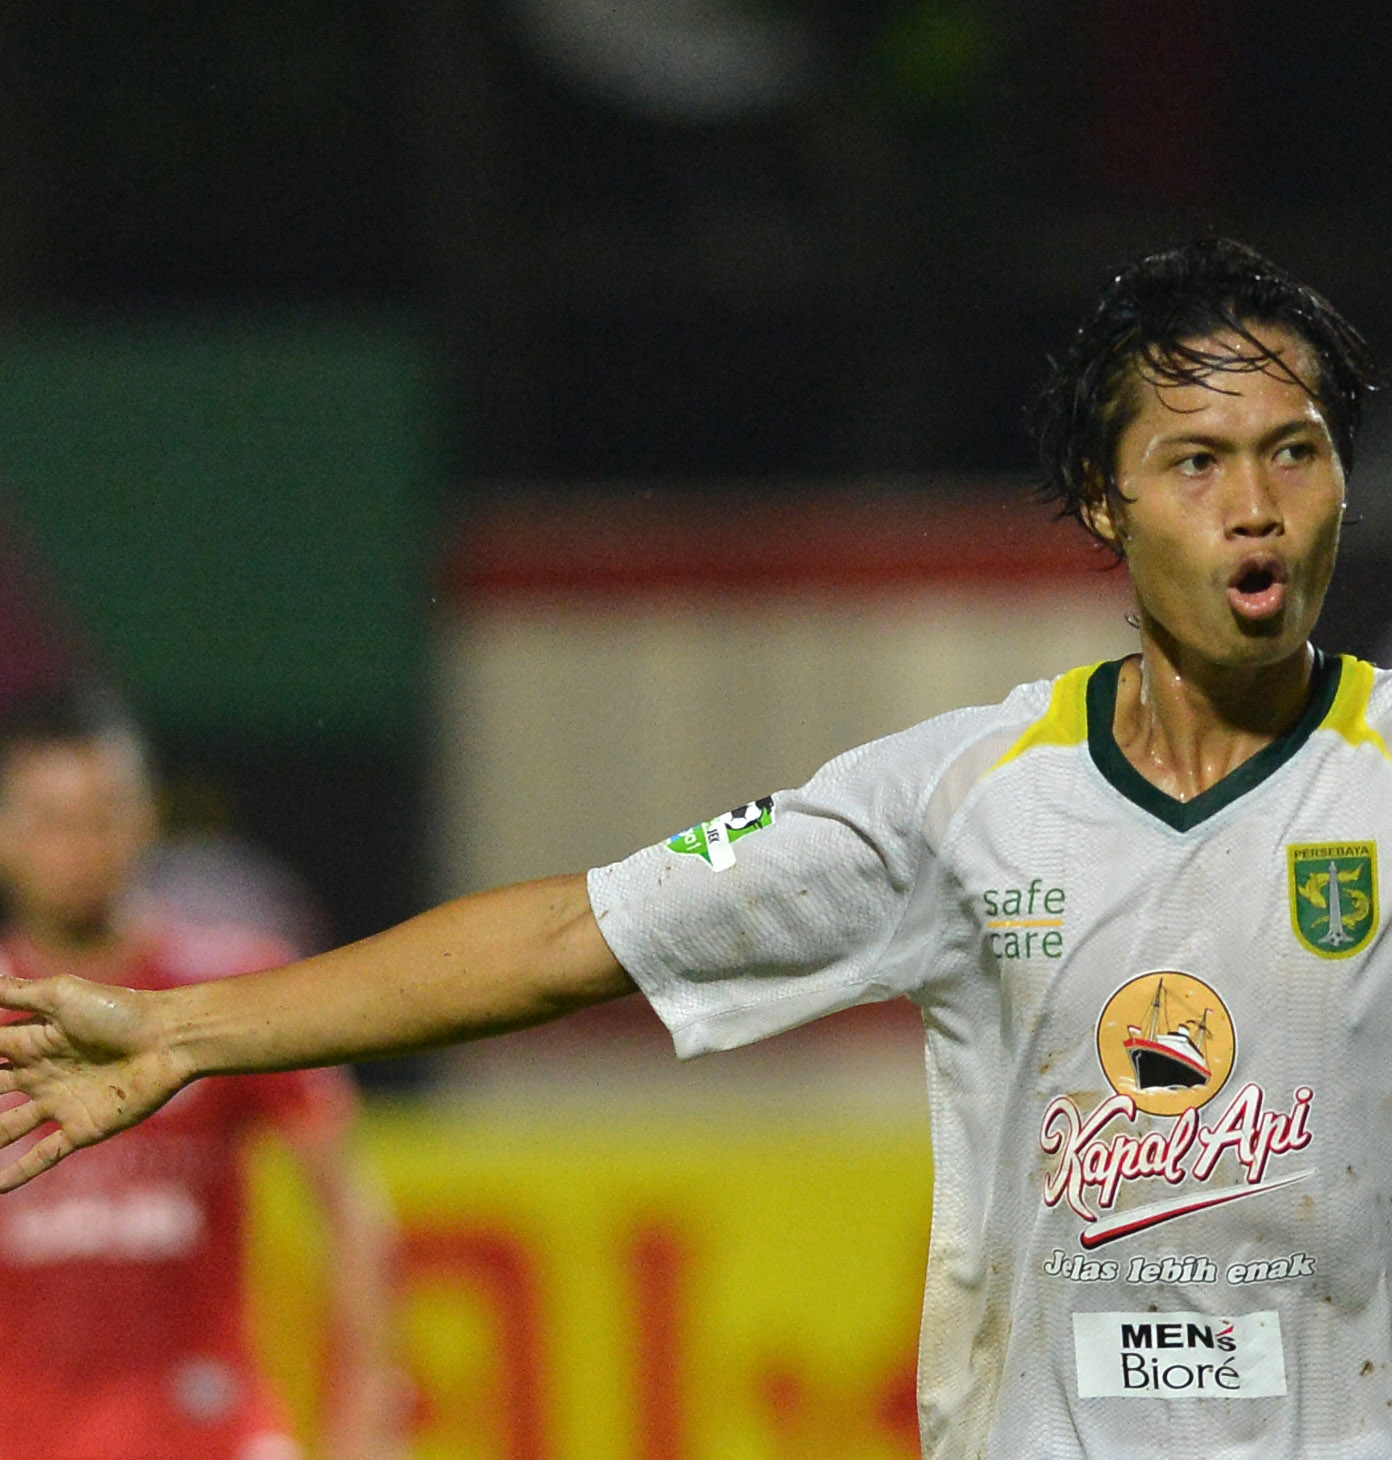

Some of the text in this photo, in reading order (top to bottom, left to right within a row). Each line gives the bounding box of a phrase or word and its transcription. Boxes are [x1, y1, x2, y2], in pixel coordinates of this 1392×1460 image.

[1294, 845, 1370, 859] PERSEBAYA
[983, 878, 1066, 916] safe
[990, 930, 1063, 959] care
[1040, 1083, 1314, 1223] Kapal Api
[1126, 1256, 1217, 1284] lebih
[1226, 1253, 1316, 1285] enak
[1121, 1352, 1241, 1390] Bioré
